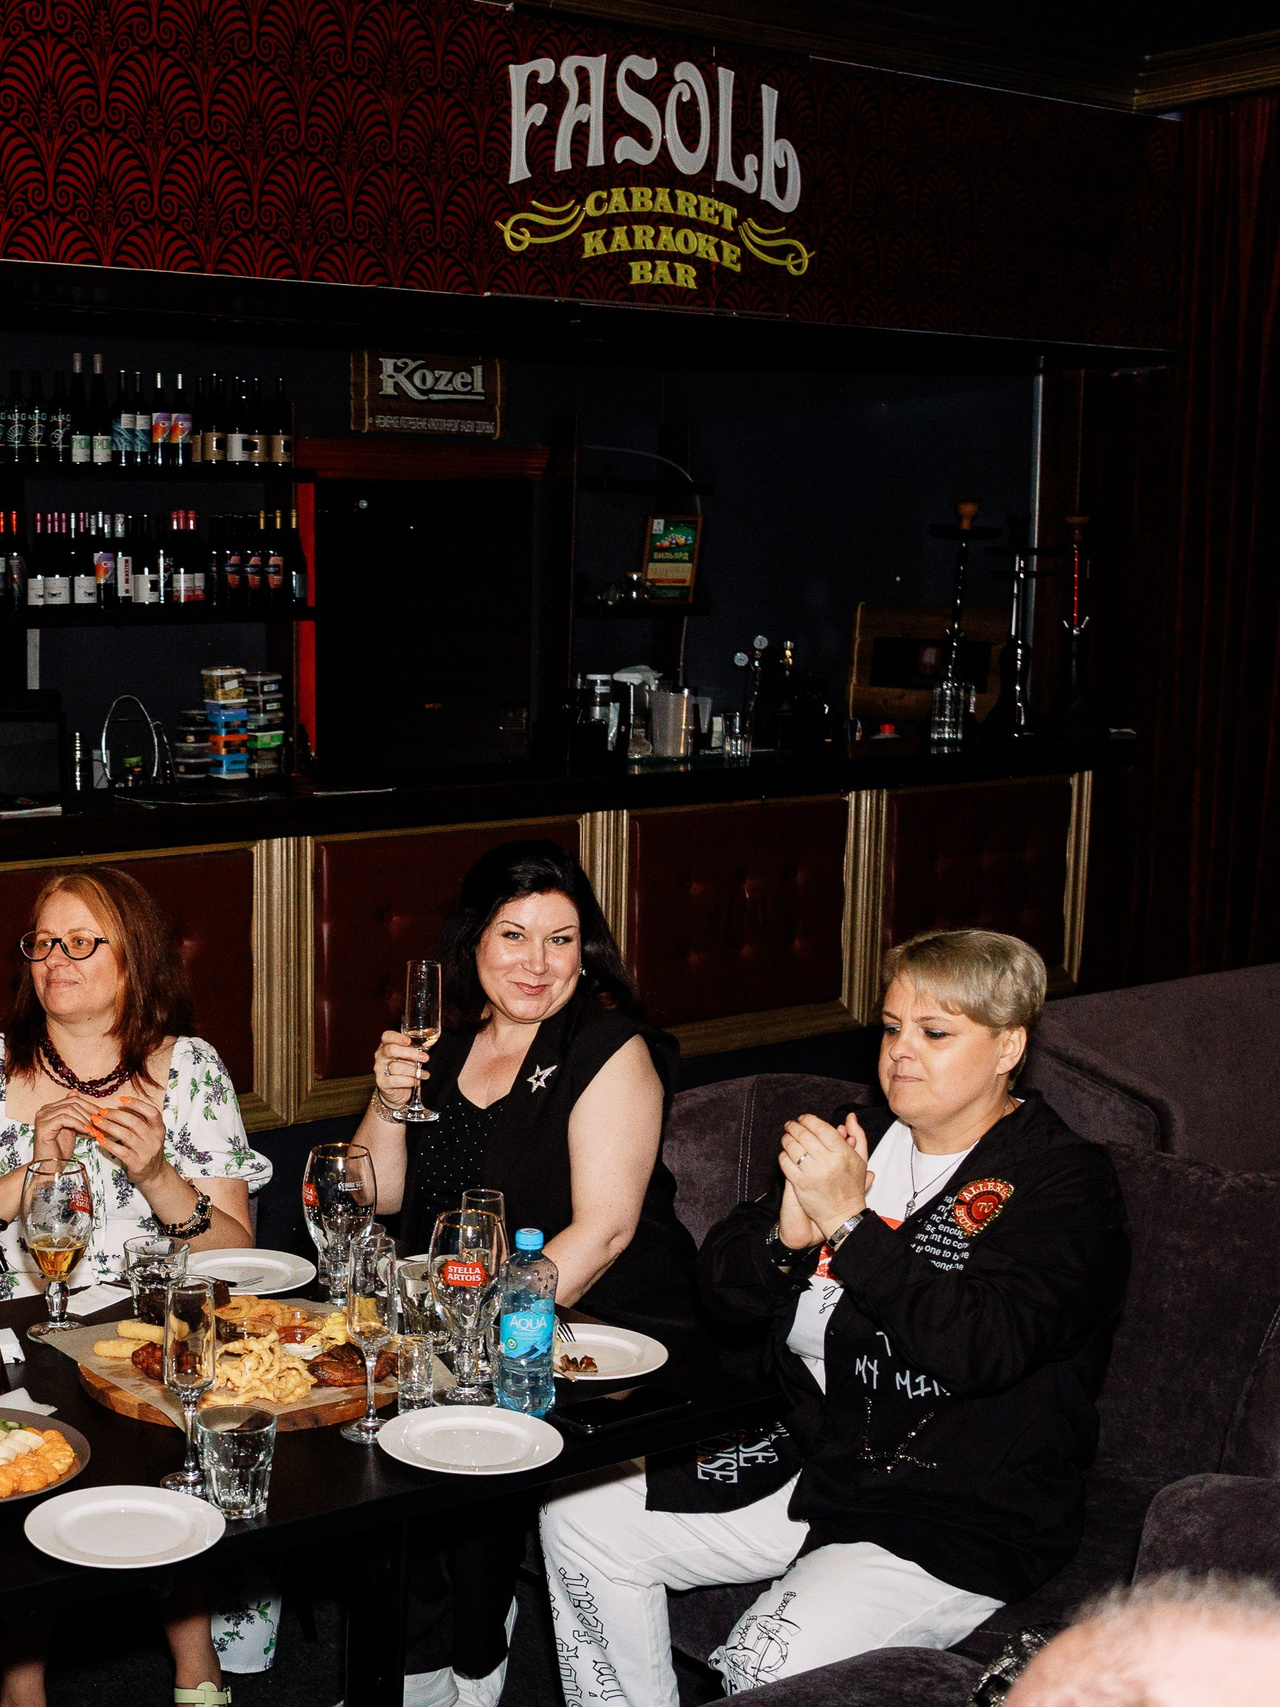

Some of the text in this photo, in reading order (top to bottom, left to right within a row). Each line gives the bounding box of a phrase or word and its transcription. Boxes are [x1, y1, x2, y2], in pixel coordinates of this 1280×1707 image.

[585, 187, 738, 232] CABARET
[581, 225, 742, 272] KARAOKE
[629, 260, 697, 290] BAR
[378, 357, 485, 400] Kozel
[653, 552, 689, 561] БИЛЬЯРД
[976, 1201, 994, 1213] TO
[447, 1273, 481, 1283] ARTOIS
[448, 1265, 481, 1274] STELLA
[510, 1315, 547, 1331] AQUA
[855, 1355, 879, 1390] MY
[558, 1567, 609, 1650] fear
